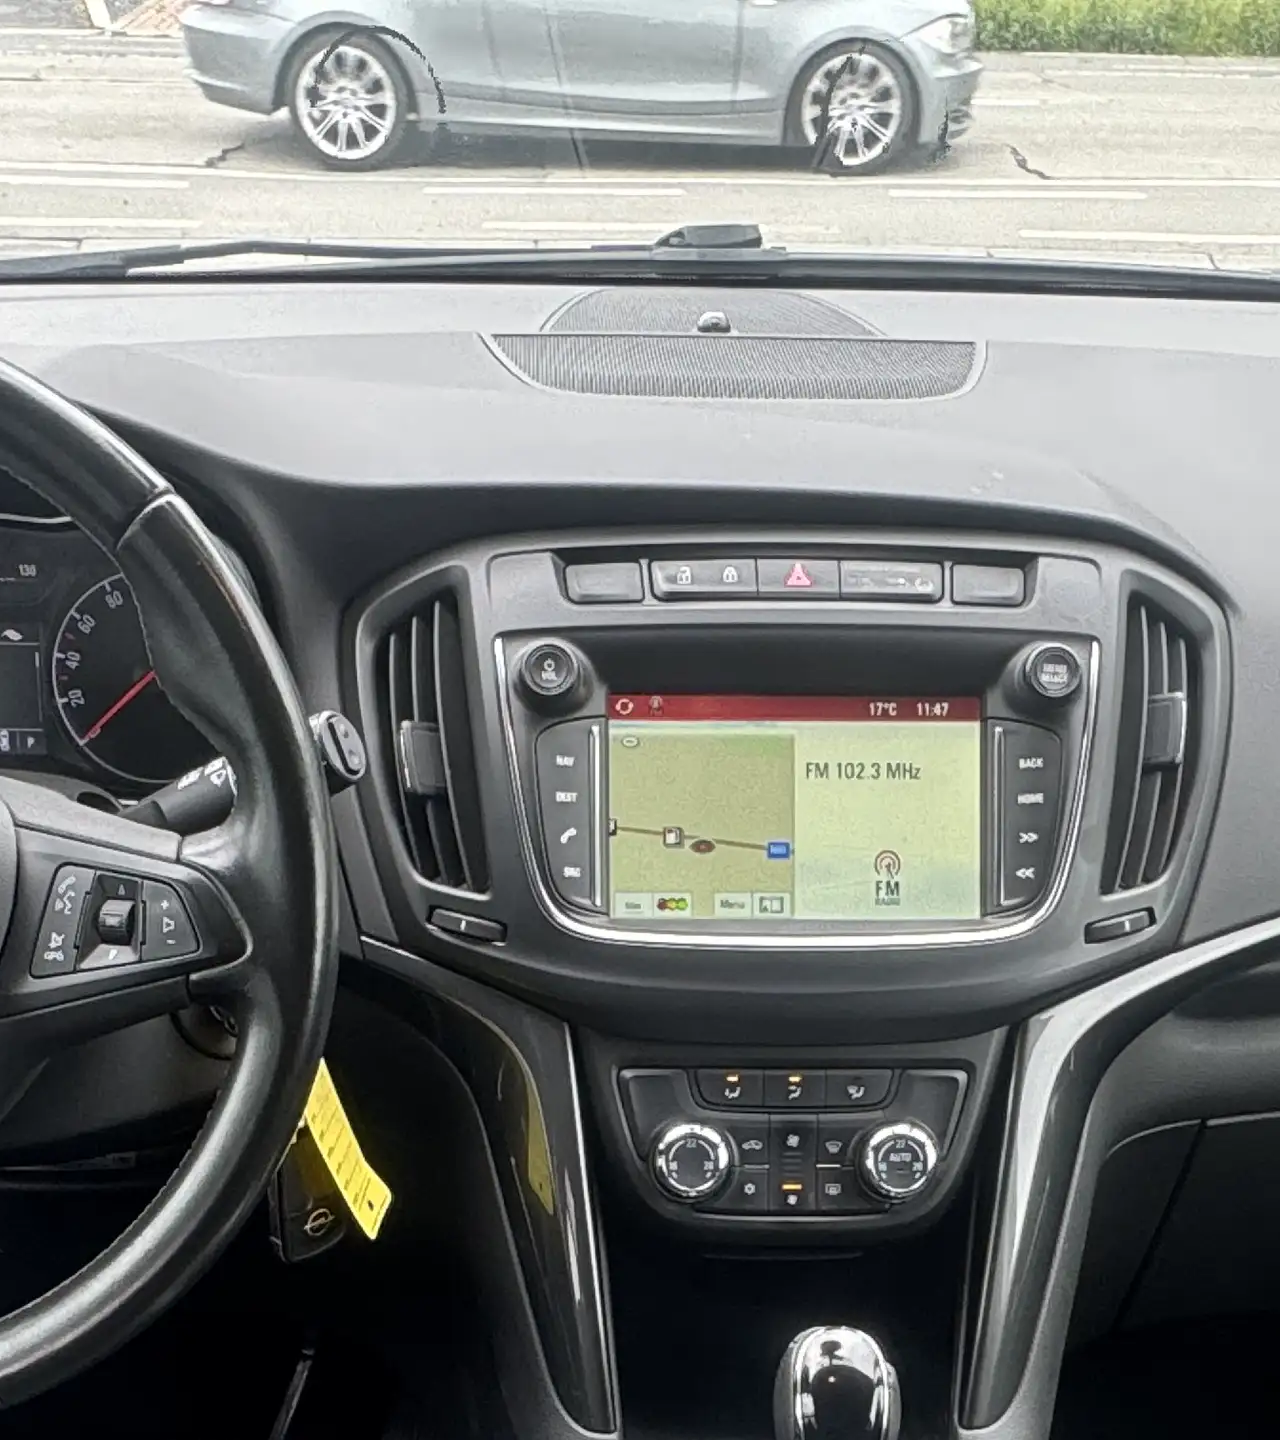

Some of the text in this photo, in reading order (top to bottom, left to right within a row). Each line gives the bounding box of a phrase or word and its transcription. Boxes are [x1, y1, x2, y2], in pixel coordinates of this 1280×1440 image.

[18, 564, 37, 577] 130
[104, 590, 124, 610] 80
[77, 614, 97, 635] 60
[65, 651, 81, 670] 40
[68, 689, 85, 707] 20
[869, 702, 949, 717] 17°C 11:47
[556, 754, 575, 767] NAV
[1019, 757, 1044, 769] BACK
[806, 762, 921, 780] FM 102.3 MHz
[555, 791, 578, 803] DEST
[875, 880, 900, 897] FM
